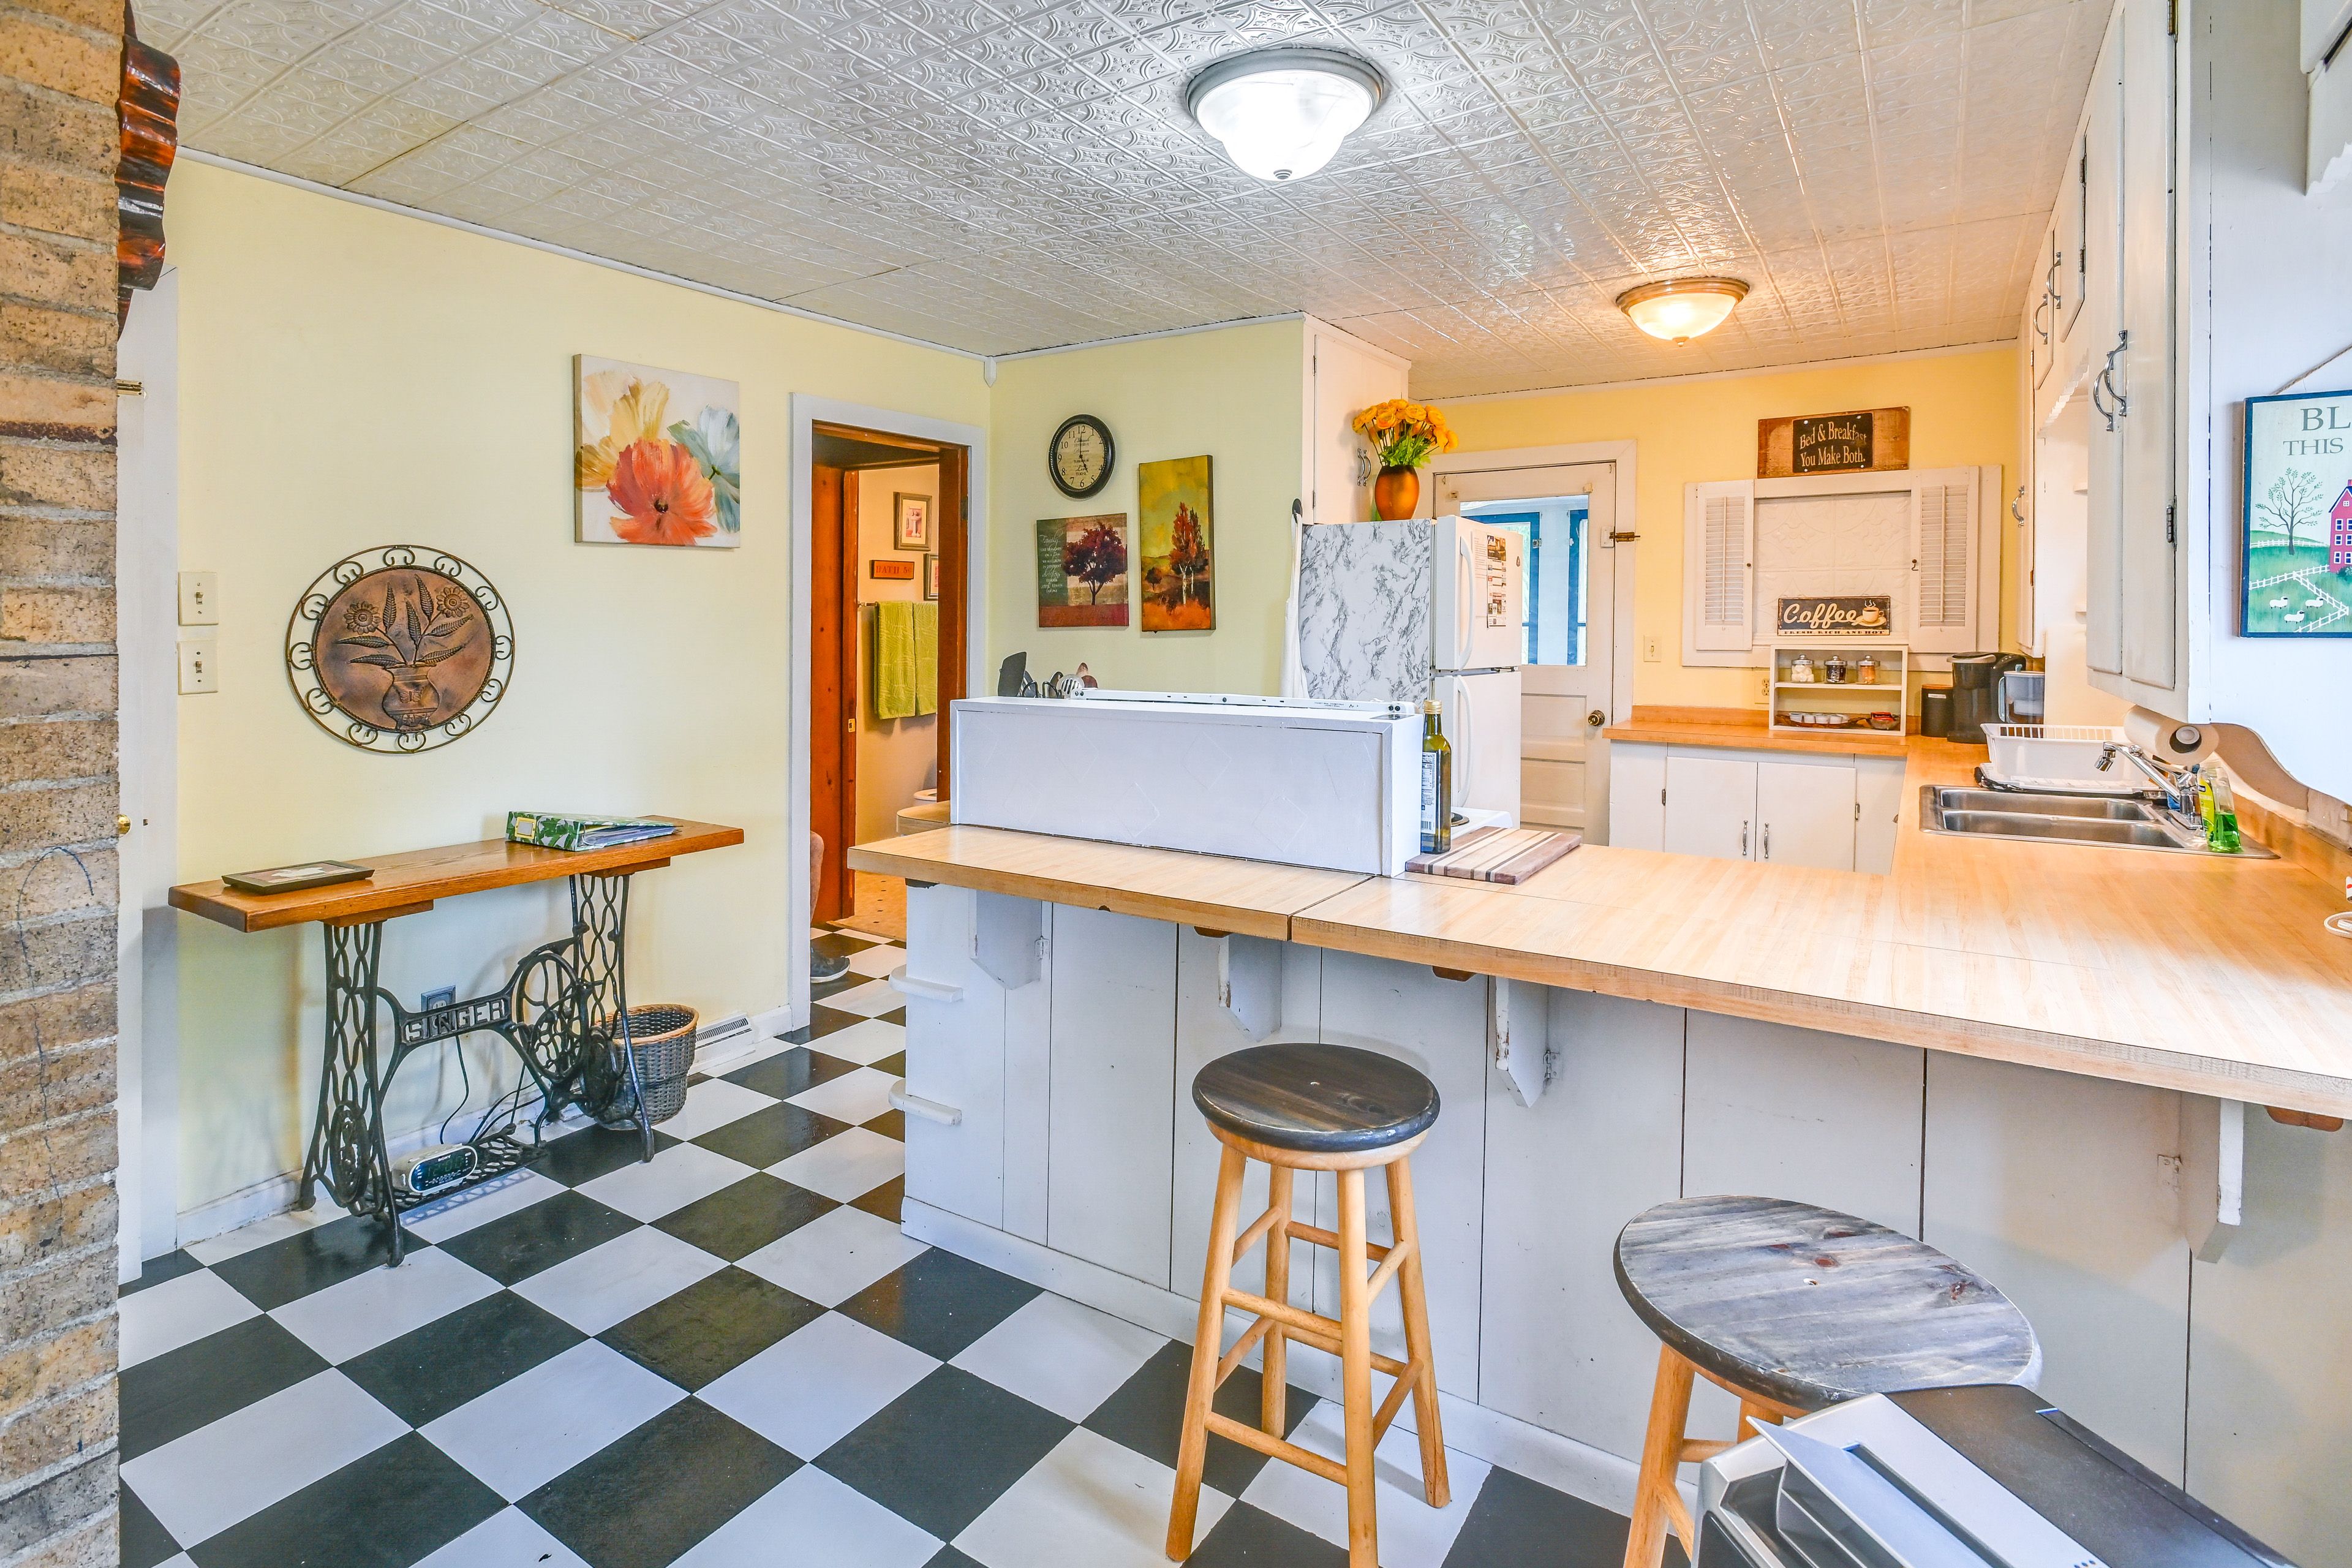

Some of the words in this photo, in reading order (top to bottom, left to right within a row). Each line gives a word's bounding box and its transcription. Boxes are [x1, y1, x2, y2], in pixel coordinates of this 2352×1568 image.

[1077, 425, 1086, 434] 12
[1800, 426, 1815, 450] Bed
[1818, 424, 1826, 442] &
[1828, 421, 1866, 445] Breakfast
[2283, 437, 2343, 456] THIS
[1058, 454, 1062, 464] 9
[1800, 452, 1815, 467] You
[1818, 445, 1841, 466] Make
[1843, 445, 1866, 464] Both.
[1061, 467, 1066, 476] 8
[1069, 477, 1075, 485] 7
[1080, 478, 1085, 488] 6
[1784, 603, 1857, 629] Coffee
[407, 999, 504, 1041] SINGER
